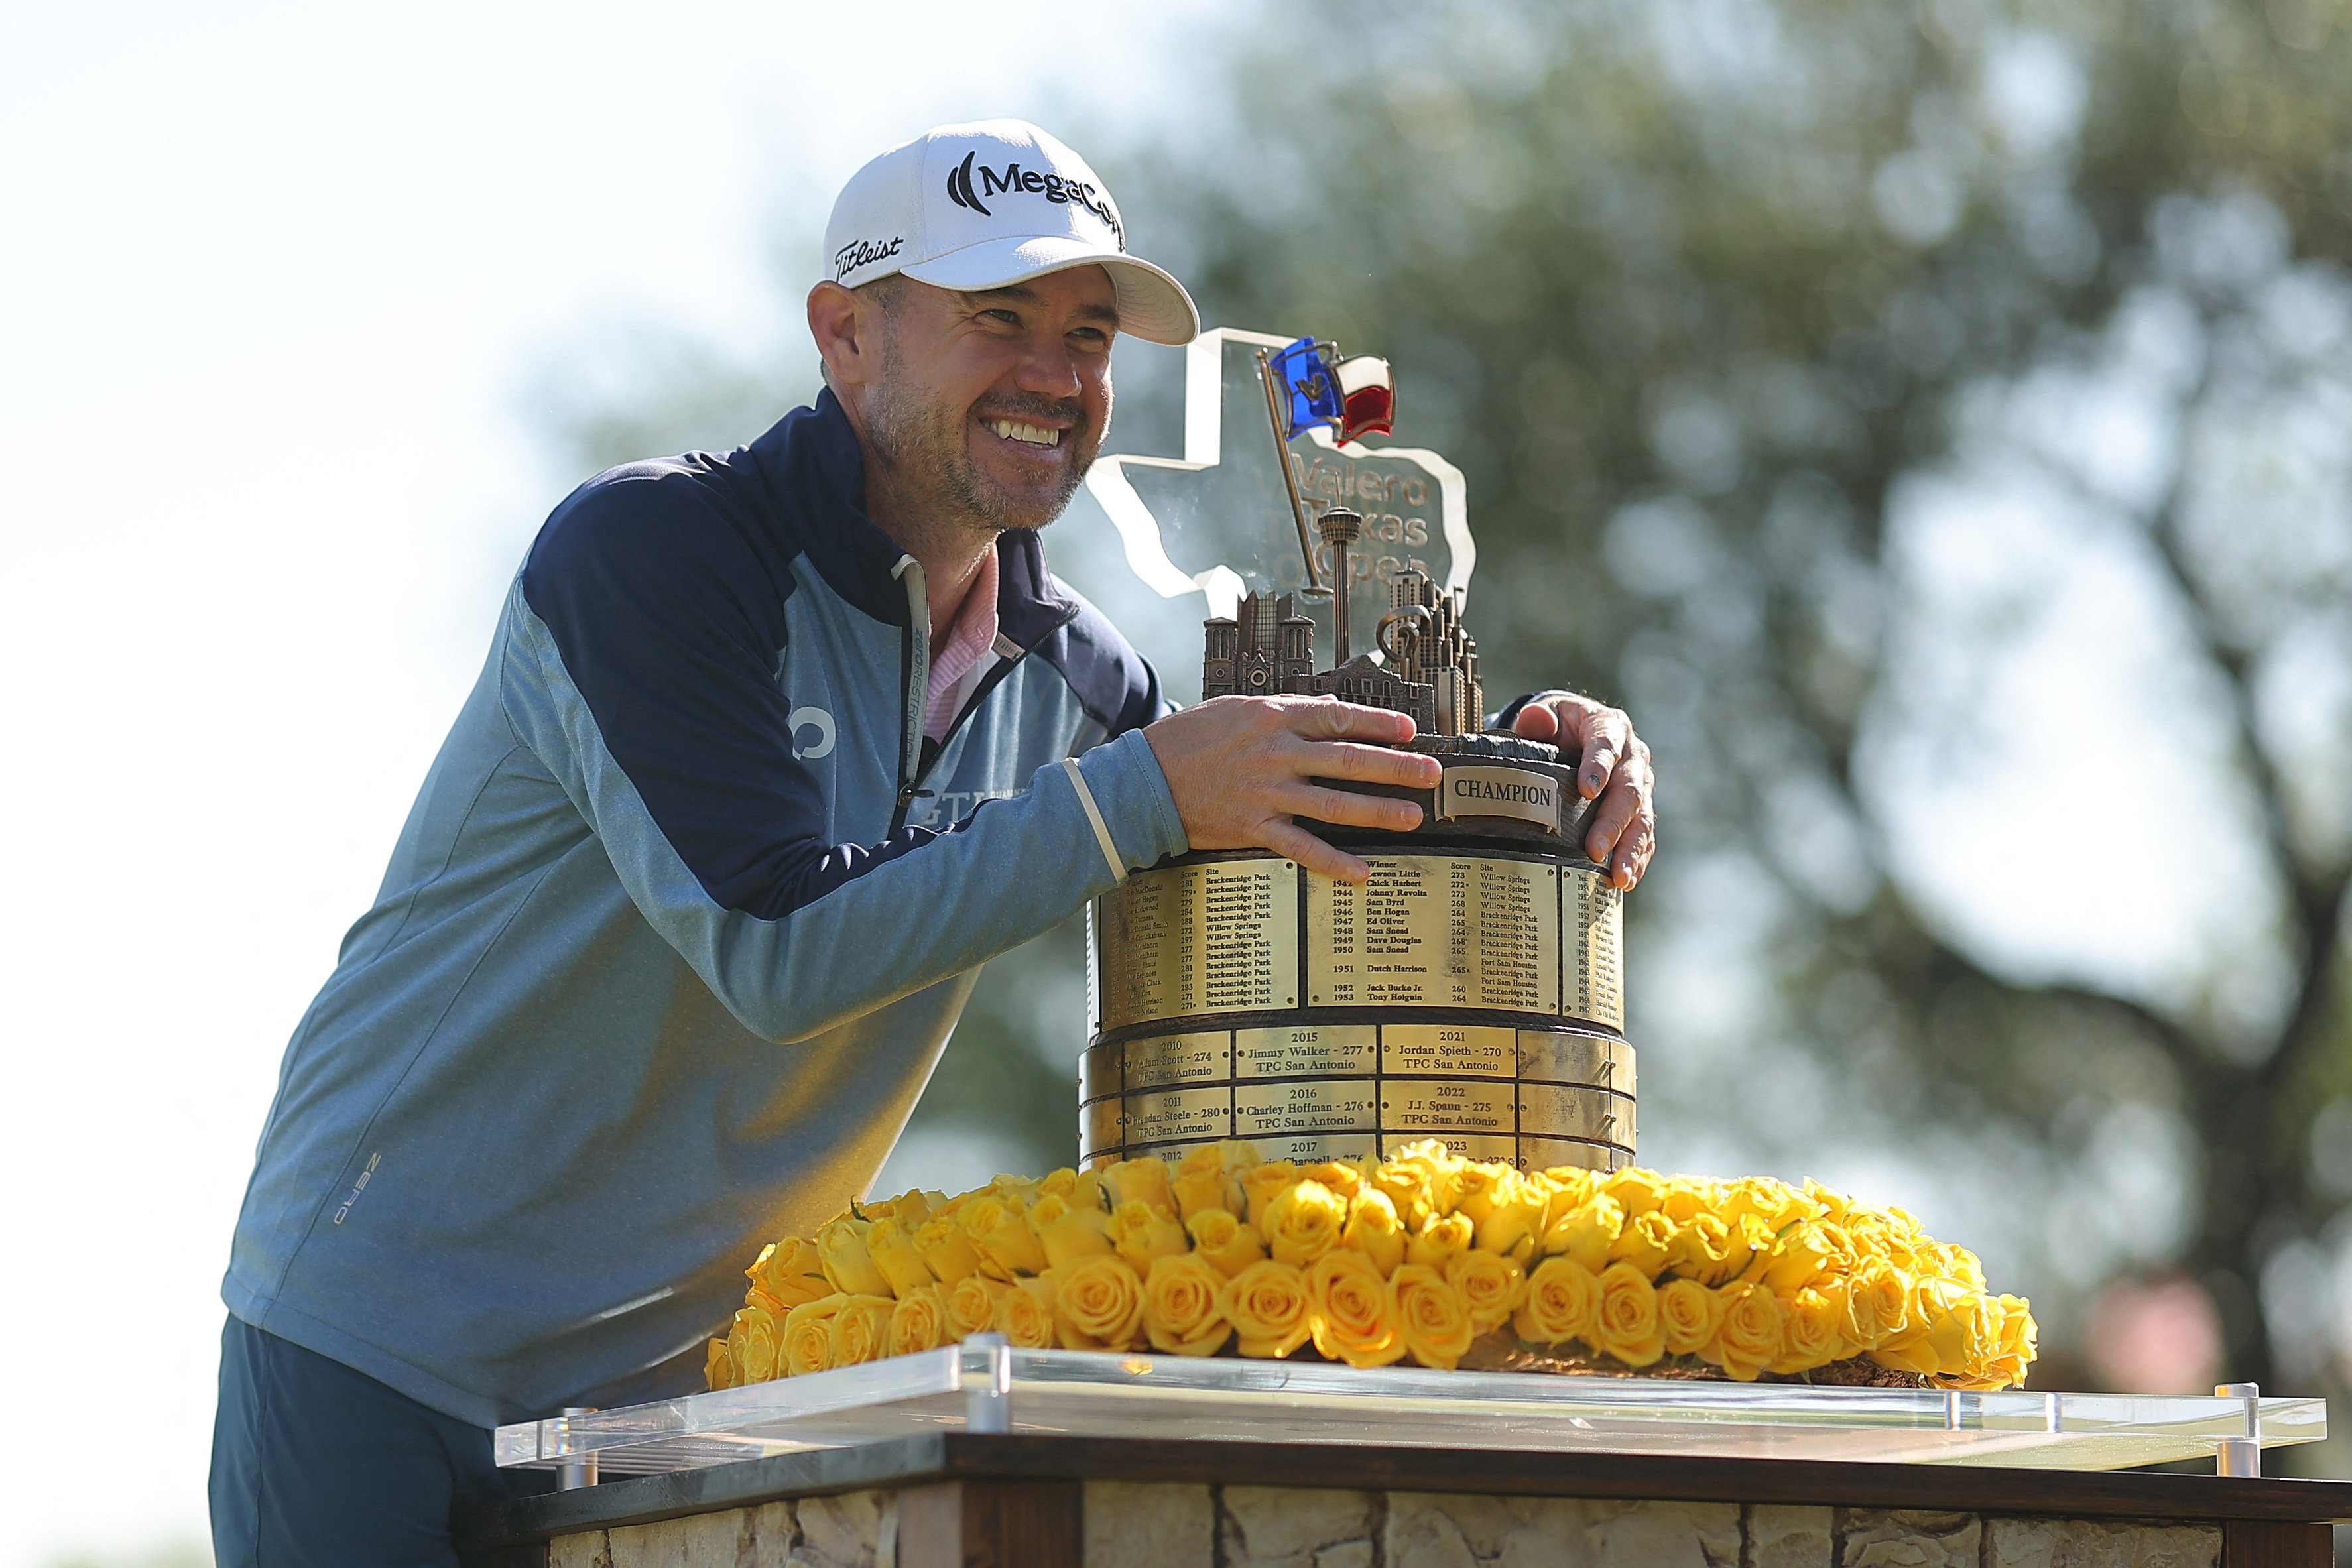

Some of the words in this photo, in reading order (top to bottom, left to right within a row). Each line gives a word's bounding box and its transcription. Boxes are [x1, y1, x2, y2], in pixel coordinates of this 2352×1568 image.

[835, 236, 904, 282] Titleist
[1292, 452, 1428, 506] Valero
[1301, 497, 1428, 547] Txas
[1455, 779, 1551, 807] CHAMPION
[1206, 874, 1252, 885] Brackenridge
[1508, 875, 1530, 885] Springs
[1480, 882, 1506, 891] Willow
[1508, 884, 1530, 894] Springs
[1480, 892, 1507, 900] Willow
[1508, 894, 1530, 904] Springs
[1206, 903, 1252, 913] Brackenridge
[1508, 904, 1530, 914] Springs
[1481, 911, 1523, 922] Brackenridge
[1206, 924, 1232, 932] Willow
[1234, 922, 1261, 931] Springs
[1481, 920, 1523, 931] Brackenridge
[1481, 930, 1523, 941] Brackenridge
[1481, 939, 1523, 950] Brackenridge
[1481, 949, 1523, 959] Brackenridge
[1513, 961, 1537, 969] Houston
[1481, 968, 1524, 979] Brackenridge
[1513, 979, 1537, 989] Houston
[1206, 989, 1252, 998] Brackenridge
[1481, 987, 1524, 998] Brackenridge
[1481, 996, 1524, 1007] Brackenridge
[1525, 999, 1538, 1008] Park
[1290, 1032, 1318, 1043] 2015
[1439, 1032, 1465, 1042] 2021
[1161, 1041, 1182, 1051] 2010
[1399, 1046, 1436, 1055] Jordan
[1439, 1046, 1471, 1057] Spieth
[1483, 1047, 1501, 1057] 270
[1248, 1048, 1284, 1059] Jimmy
[1290, 1046, 1330, 1057] Walker
[1342, 1046, 1363, 1055] 277
[1162, 1055, 1184, 1065] Scott
[1194, 1052, 1212, 1062] 274
[1257, 1061, 1282, 1072] TPC
[1284, 1061, 1306, 1071] San
[1309, 1059, 1355, 1070] Antonio
[1403, 1059, 1430, 1069] TPC
[1433, 1059, 1454, 1069] San
[1457, 1060, 1499, 1071] Antonio
[1175, 1066, 1212, 1077] Antonio
[1290, 1089, 1317, 1099] 2016
[1436, 1087, 1465, 1097] 2022
[1162, 1097, 1181, 1107] 2011
[1428, 1101, 1461, 1113] Spaun
[1473, 1102, 1491, 1112] 275
[1247, 1105, 1283, 1116] Charley
[1286, 1103, 1333, 1113] Hoffman
[1344, 1101, 1364, 1111] 276
[1132, 1114, 1162, 1125] Brendan
[1164, 1111, 1191, 1121] Steele
[1201, 1108, 1220, 1118] 280
[1255, 1118, 1281, 1129] TPC
[1284, 1117, 1305, 1127] San
[1308, 1115, 1355, 1126] Antonio
[1402, 1115, 1428, 1124] TPC
[1432, 1115, 1453, 1124] San
[1457, 1116, 1497, 1126] Antonio
[1157, 1126, 1172, 1136] San
[1175, 1122, 1213, 1134] Antonio
[1291, 1142, 1318, 1152] 2017
[1441, 1141, 1467, 1151] 023
[1162, 1151, 1182, 1161] 2012
